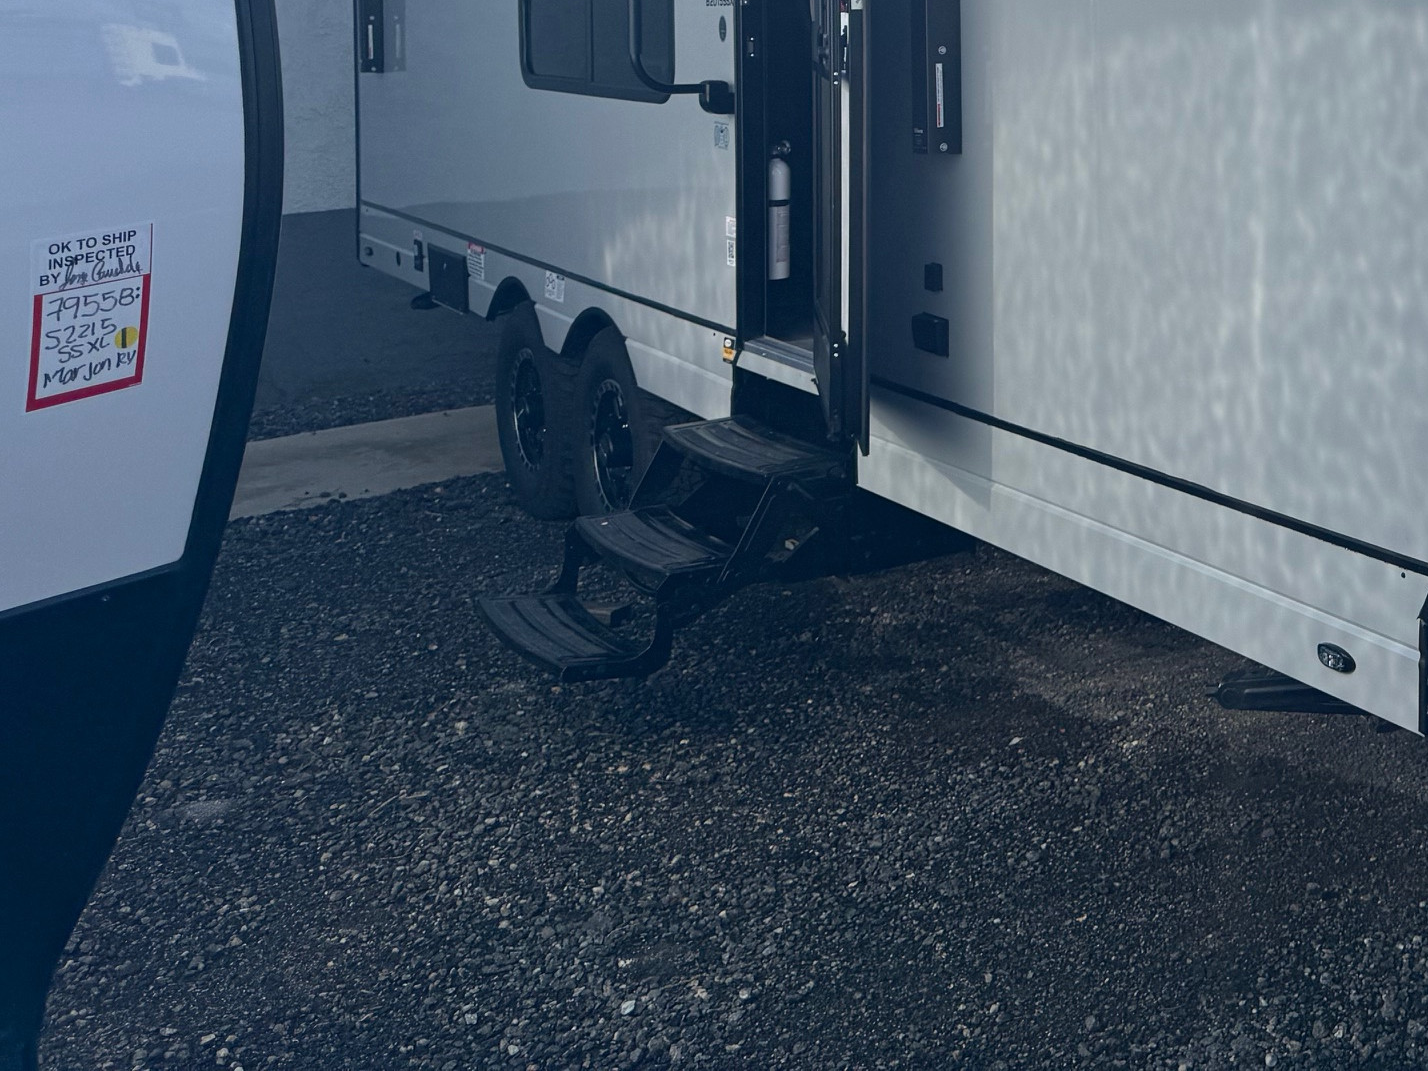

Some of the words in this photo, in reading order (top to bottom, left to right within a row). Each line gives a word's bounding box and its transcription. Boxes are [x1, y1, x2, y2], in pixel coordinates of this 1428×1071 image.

[48, 241, 71, 255] OK
[76, 237, 97, 250] TO
[102, 230, 136, 246] SHIP
[48, 245, 136, 270] INSPECTED
[39, 272, 61, 286] BY
